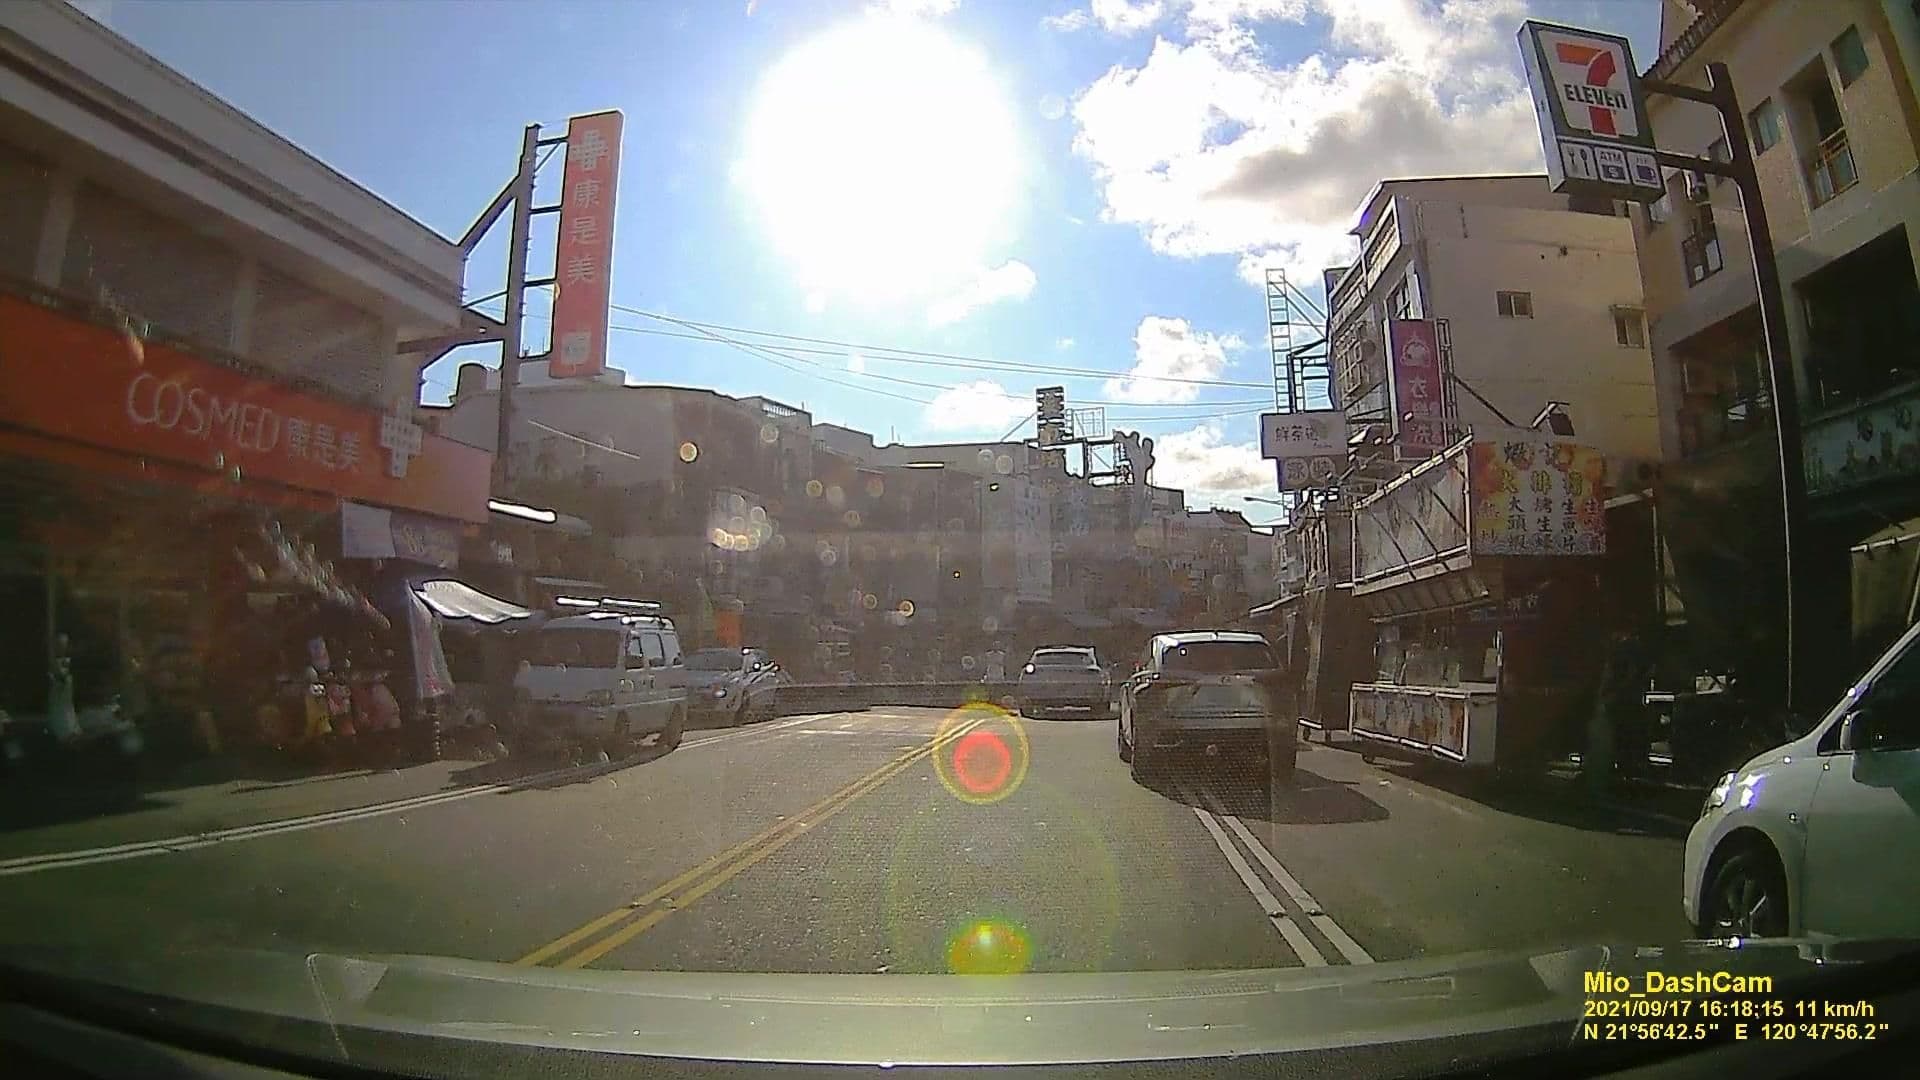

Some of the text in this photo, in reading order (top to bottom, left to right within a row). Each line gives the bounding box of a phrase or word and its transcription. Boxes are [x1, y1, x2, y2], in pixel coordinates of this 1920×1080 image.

[1556, 43, 1617, 136] 7
[1599, 150, 1622, 164] ATM
[566, 179, 602, 286] 康是美
[127, 372, 281, 452] COSMED
